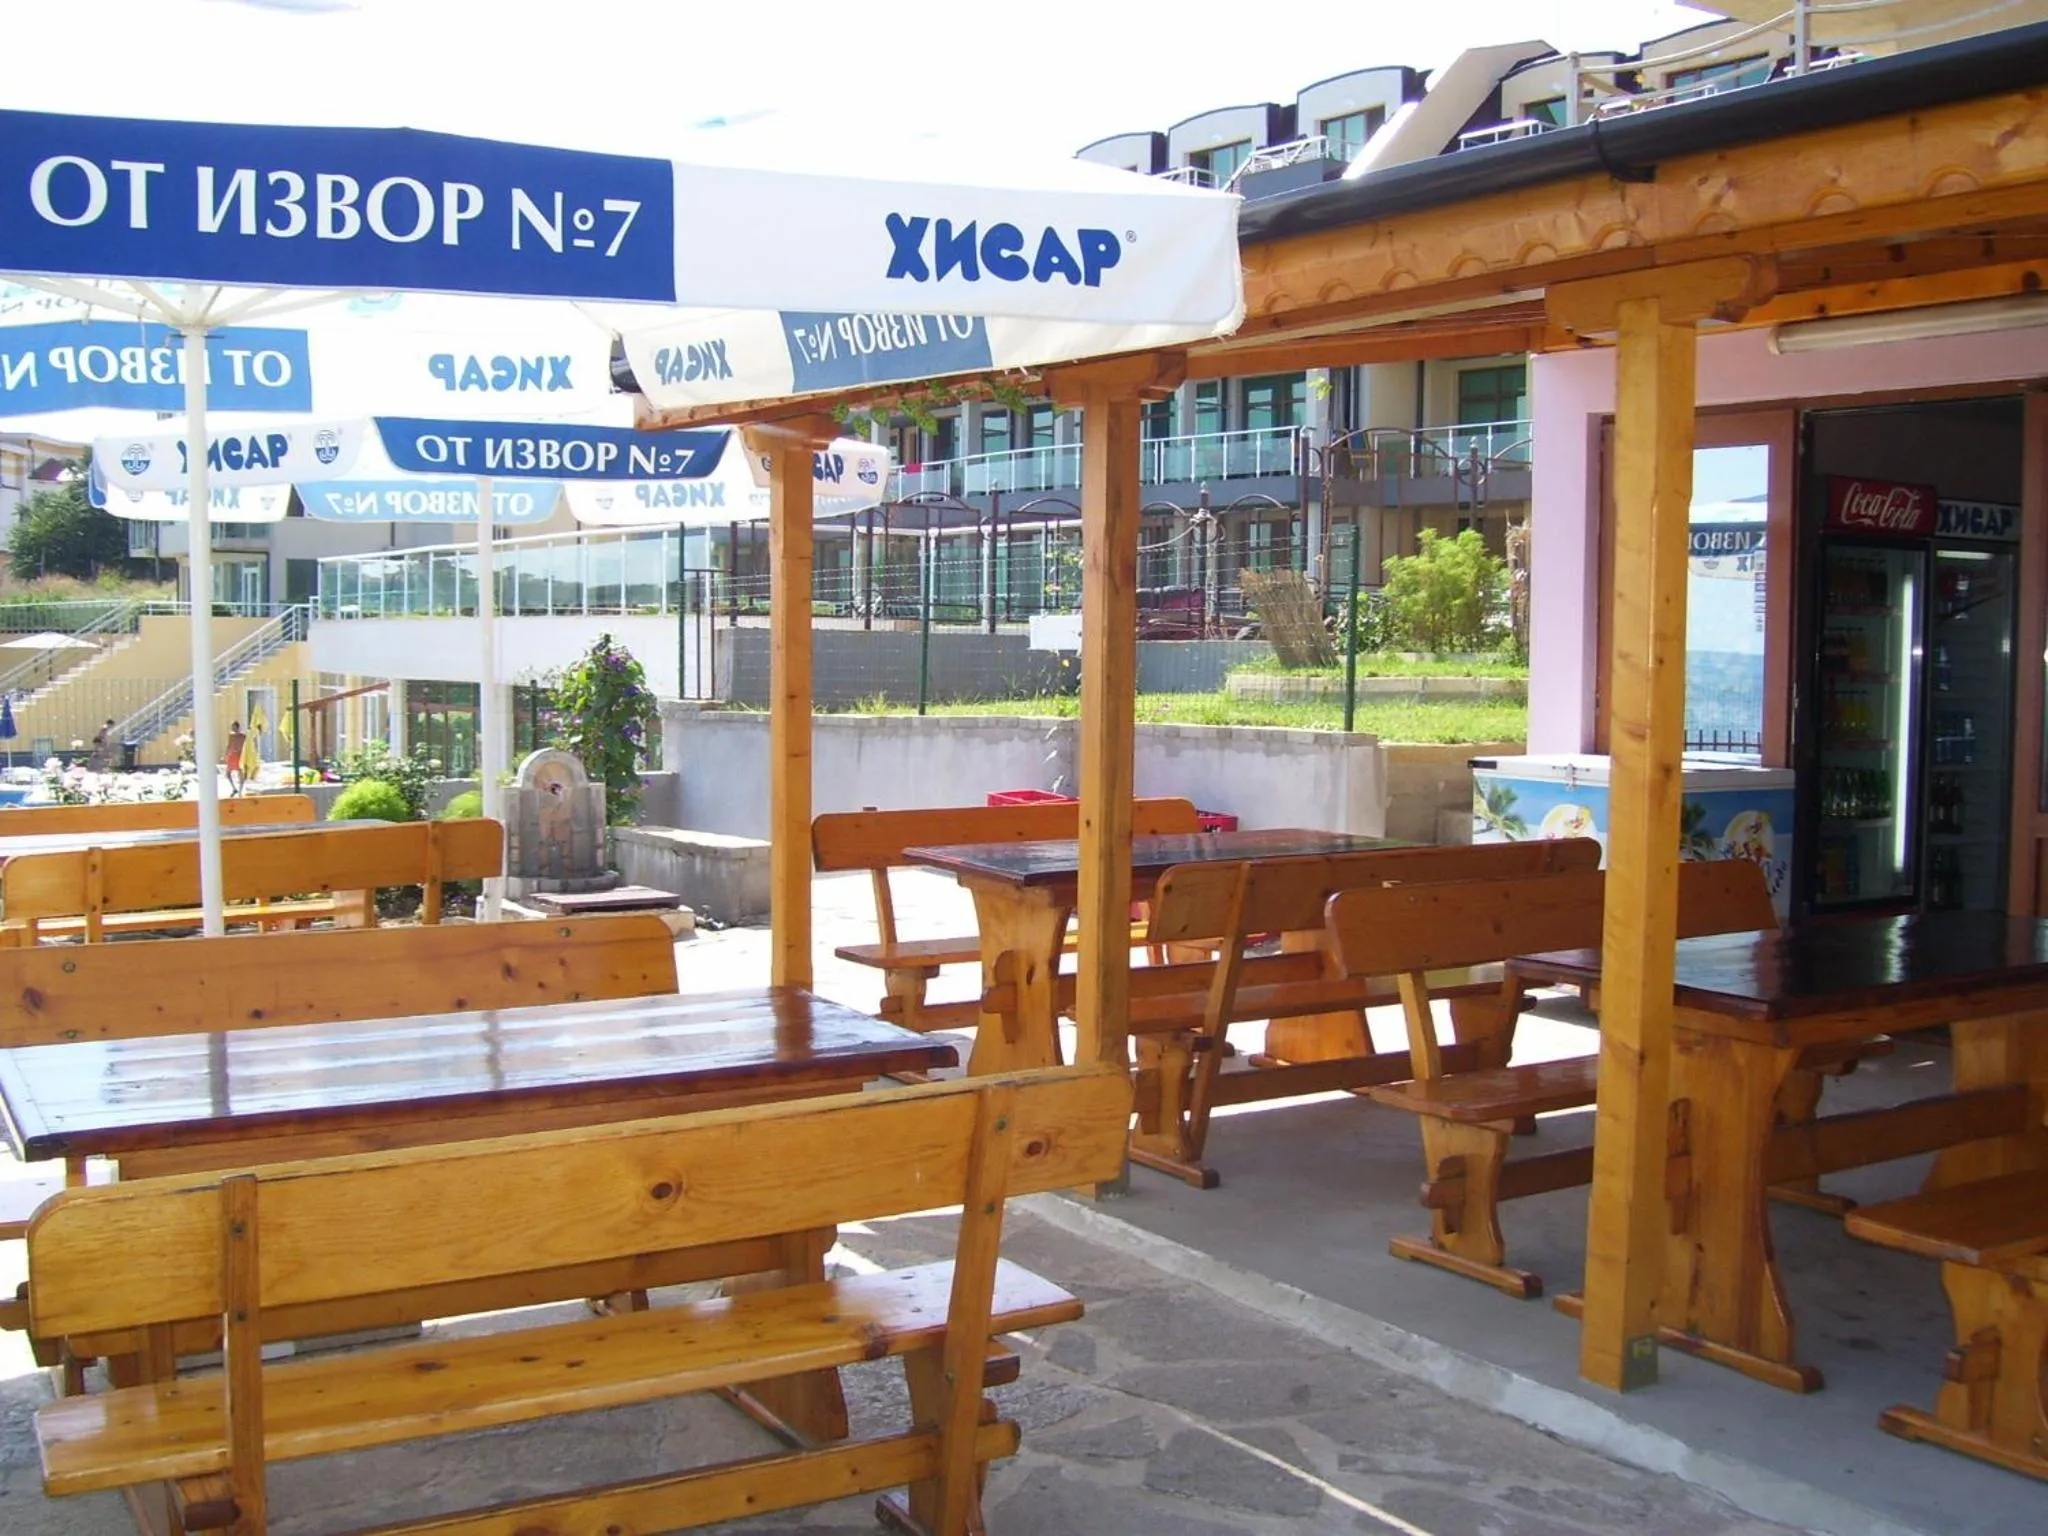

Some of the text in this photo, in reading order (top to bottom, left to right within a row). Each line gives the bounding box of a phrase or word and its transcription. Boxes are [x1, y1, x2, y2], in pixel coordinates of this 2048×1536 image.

[29, 154, 642, 257] ОТ ИЗВОР №7
[415, 434, 695, 475] ОТ ИЗВОР №7
[1937, 503, 2014, 537] ХИСАР
